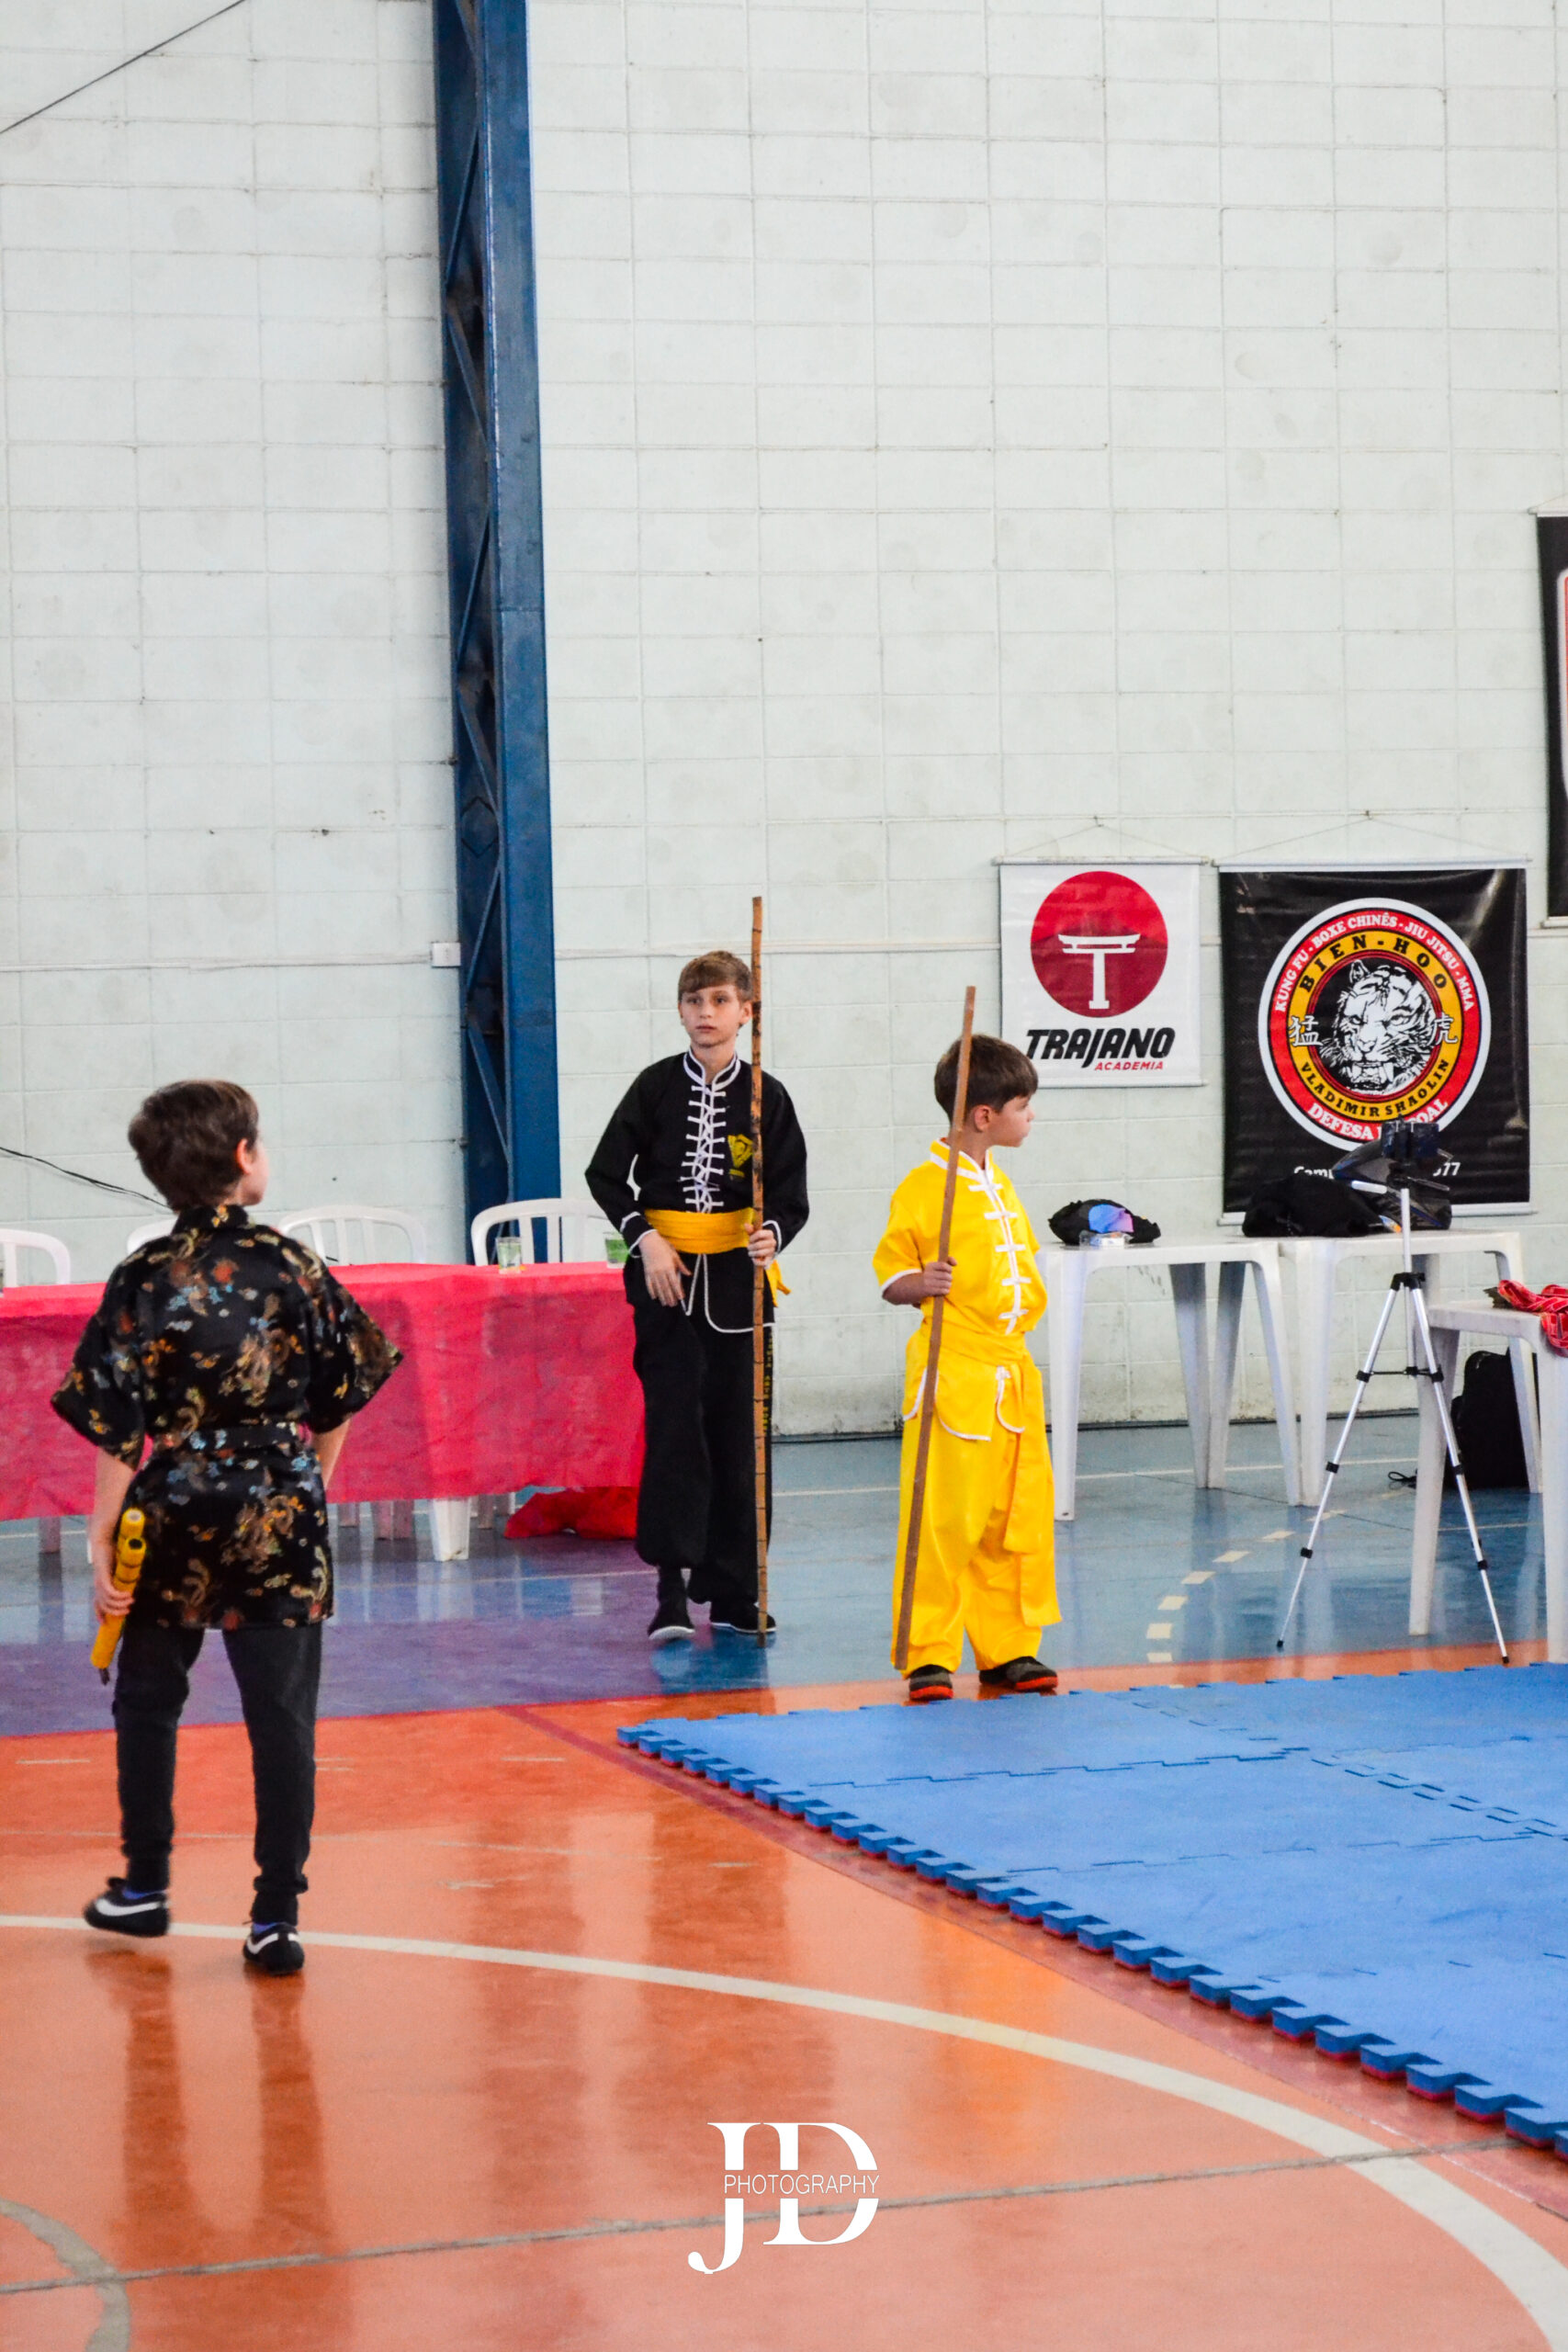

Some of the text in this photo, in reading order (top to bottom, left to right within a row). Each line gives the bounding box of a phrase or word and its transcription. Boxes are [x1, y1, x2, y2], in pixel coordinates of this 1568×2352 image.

[1275, 912, 1474, 1012] KUNG FU BOXE CHINÊS JIU JITSU MMA
[1026, 1027, 1176, 1069] TRAJANO
[1288, 1012, 1459, 1046] 猛 虎
[1094, 1061, 1164, 1071] ACADEMIA
[1300, 1059, 1450, 1117] VLADIMIR SHAOLIN
[1307, 1102, 1374, 1140] DEFESA
